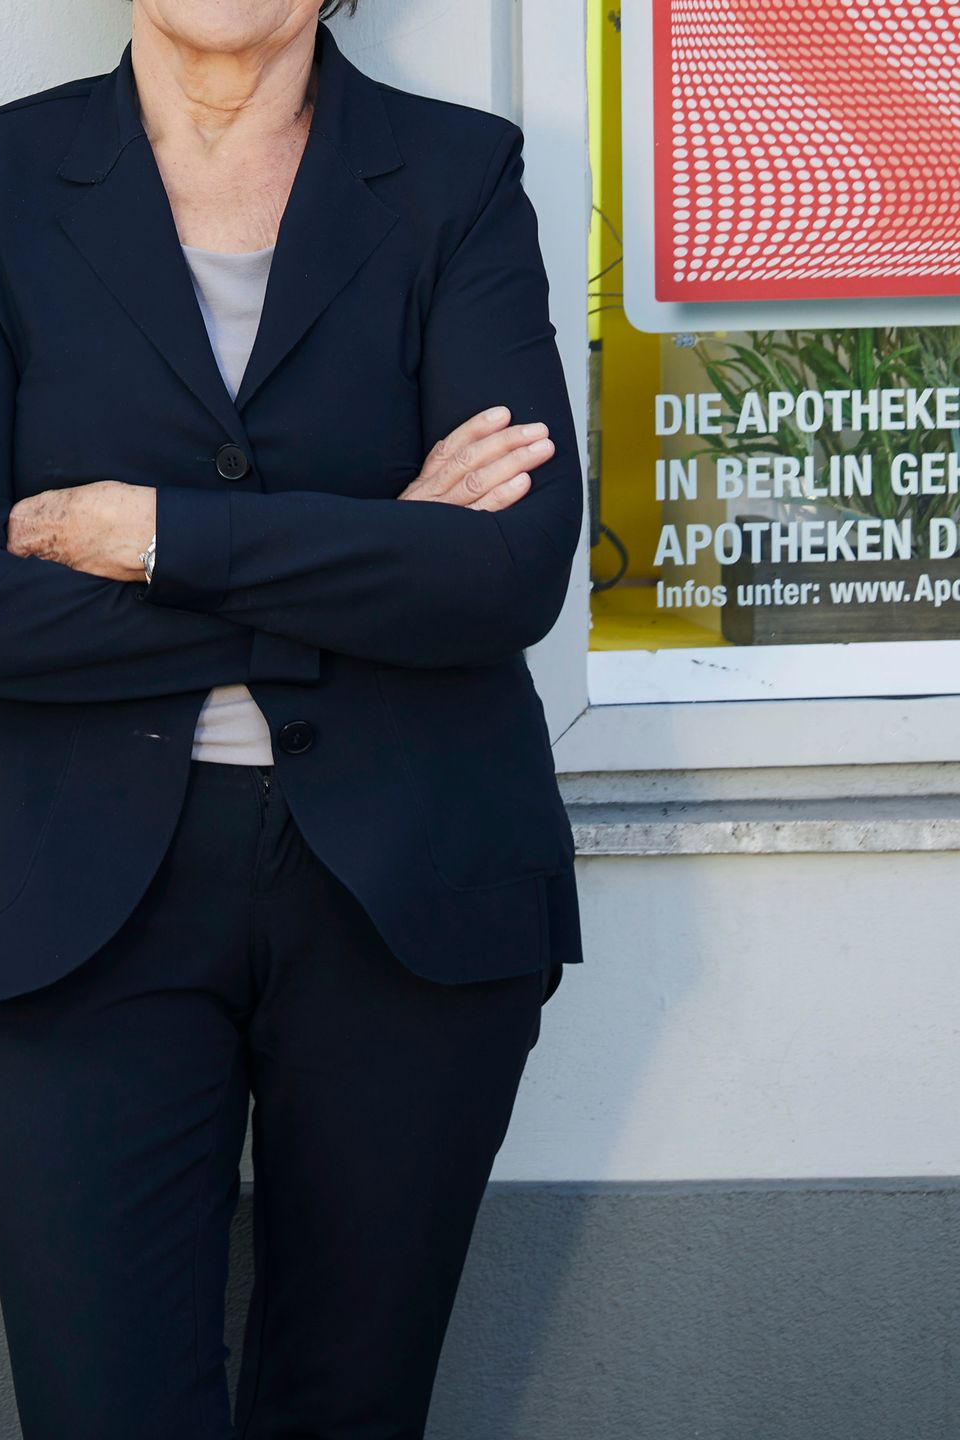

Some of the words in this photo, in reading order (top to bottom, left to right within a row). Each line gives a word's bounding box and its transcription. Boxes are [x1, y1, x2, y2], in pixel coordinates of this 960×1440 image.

[654, 393, 722, 436] DIE
[736, 387, 960, 434] APOTHEKE
[655, 459, 697, 500] IN
[716, 455, 872, 500] BERLIN
[653, 518, 912, 566] APOTHEKEN
[656, 580, 727, 608] Infos
[737, 578, 820, 607] unter:
